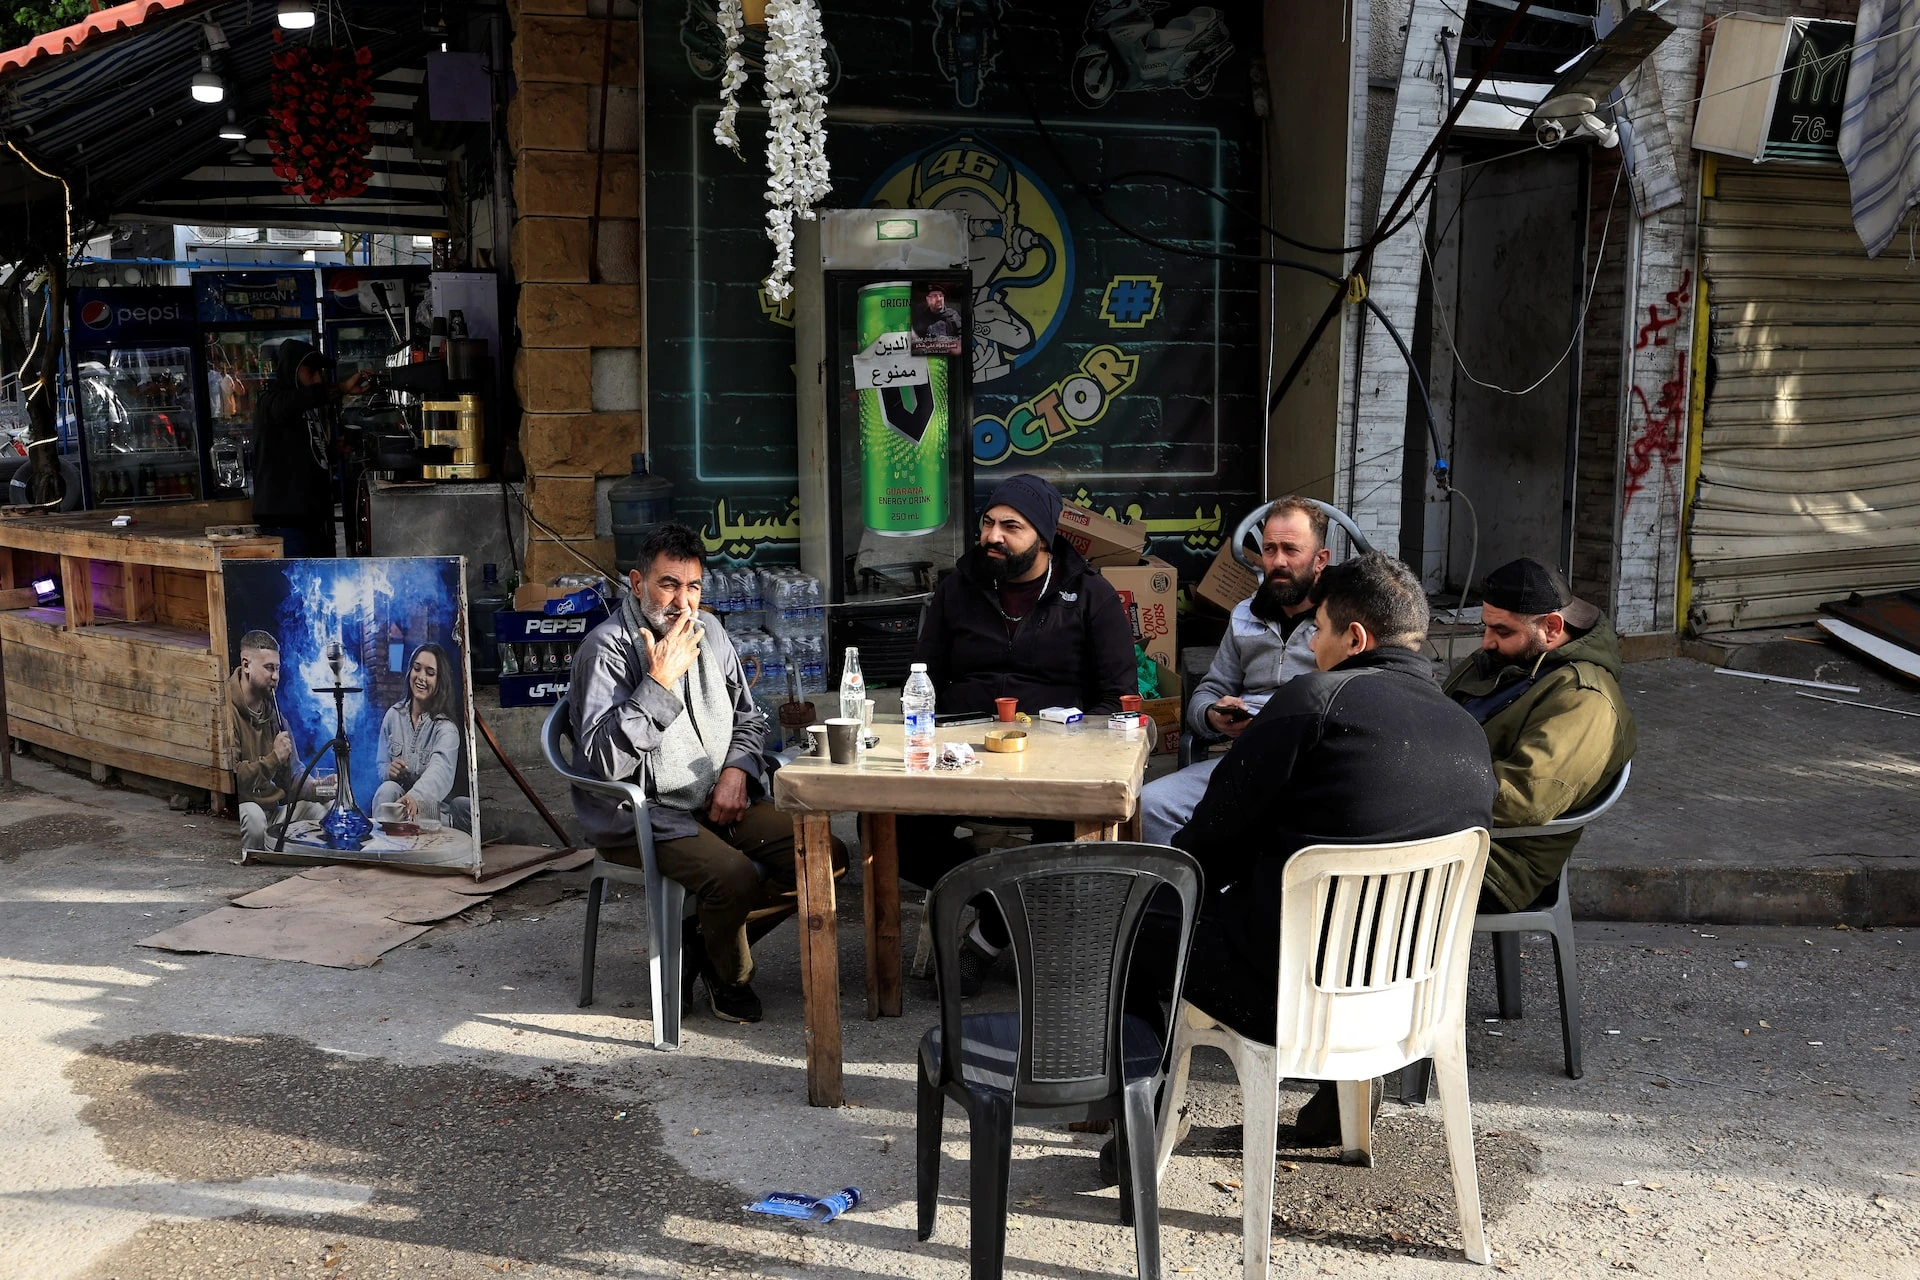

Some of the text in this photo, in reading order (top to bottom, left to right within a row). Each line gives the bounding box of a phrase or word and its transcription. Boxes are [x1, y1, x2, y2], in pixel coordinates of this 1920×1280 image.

[927, 150, 1000, 182] 46
[117, 301, 181, 327] pepsi
[880, 298, 911, 309] ORIGIN
[871, 362, 917, 386] ممنوع
[973, 345, 1138, 465] OCTOR
[878, 494, 932, 505] ENERGY DRINK
[885, 486, 923, 496] GUARANA
[891, 512, 907, 521] 250
[525, 618, 587, 634] PEPSI
[1142, 607, 1157, 641] CORN
[1154, 603, 1169, 635] COBS
